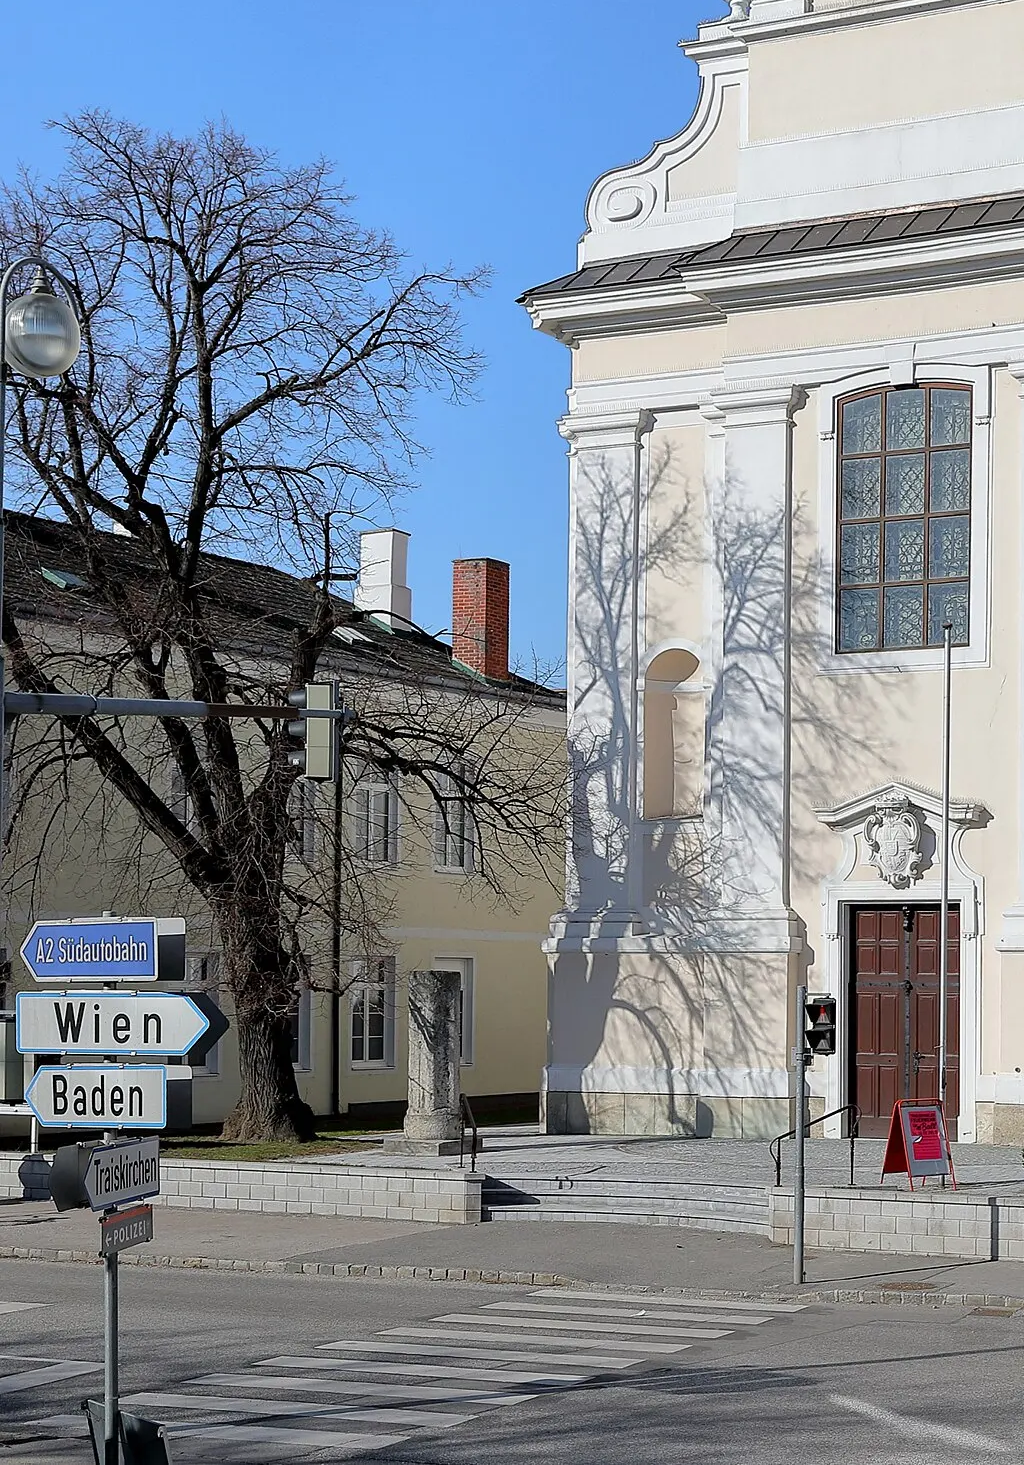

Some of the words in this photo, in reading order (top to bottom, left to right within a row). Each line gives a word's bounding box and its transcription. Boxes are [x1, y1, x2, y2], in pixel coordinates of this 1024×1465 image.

[35, 938, 54, 963] A2
[58, 935, 148, 964] Südautobahn
[54, 1002, 162, 1044] Wien
[52, 1074, 143, 1117] Baden
[93, 1150, 157, 1196] Traiskirchen
[113, 1220, 146, 1245] POLIZEI
